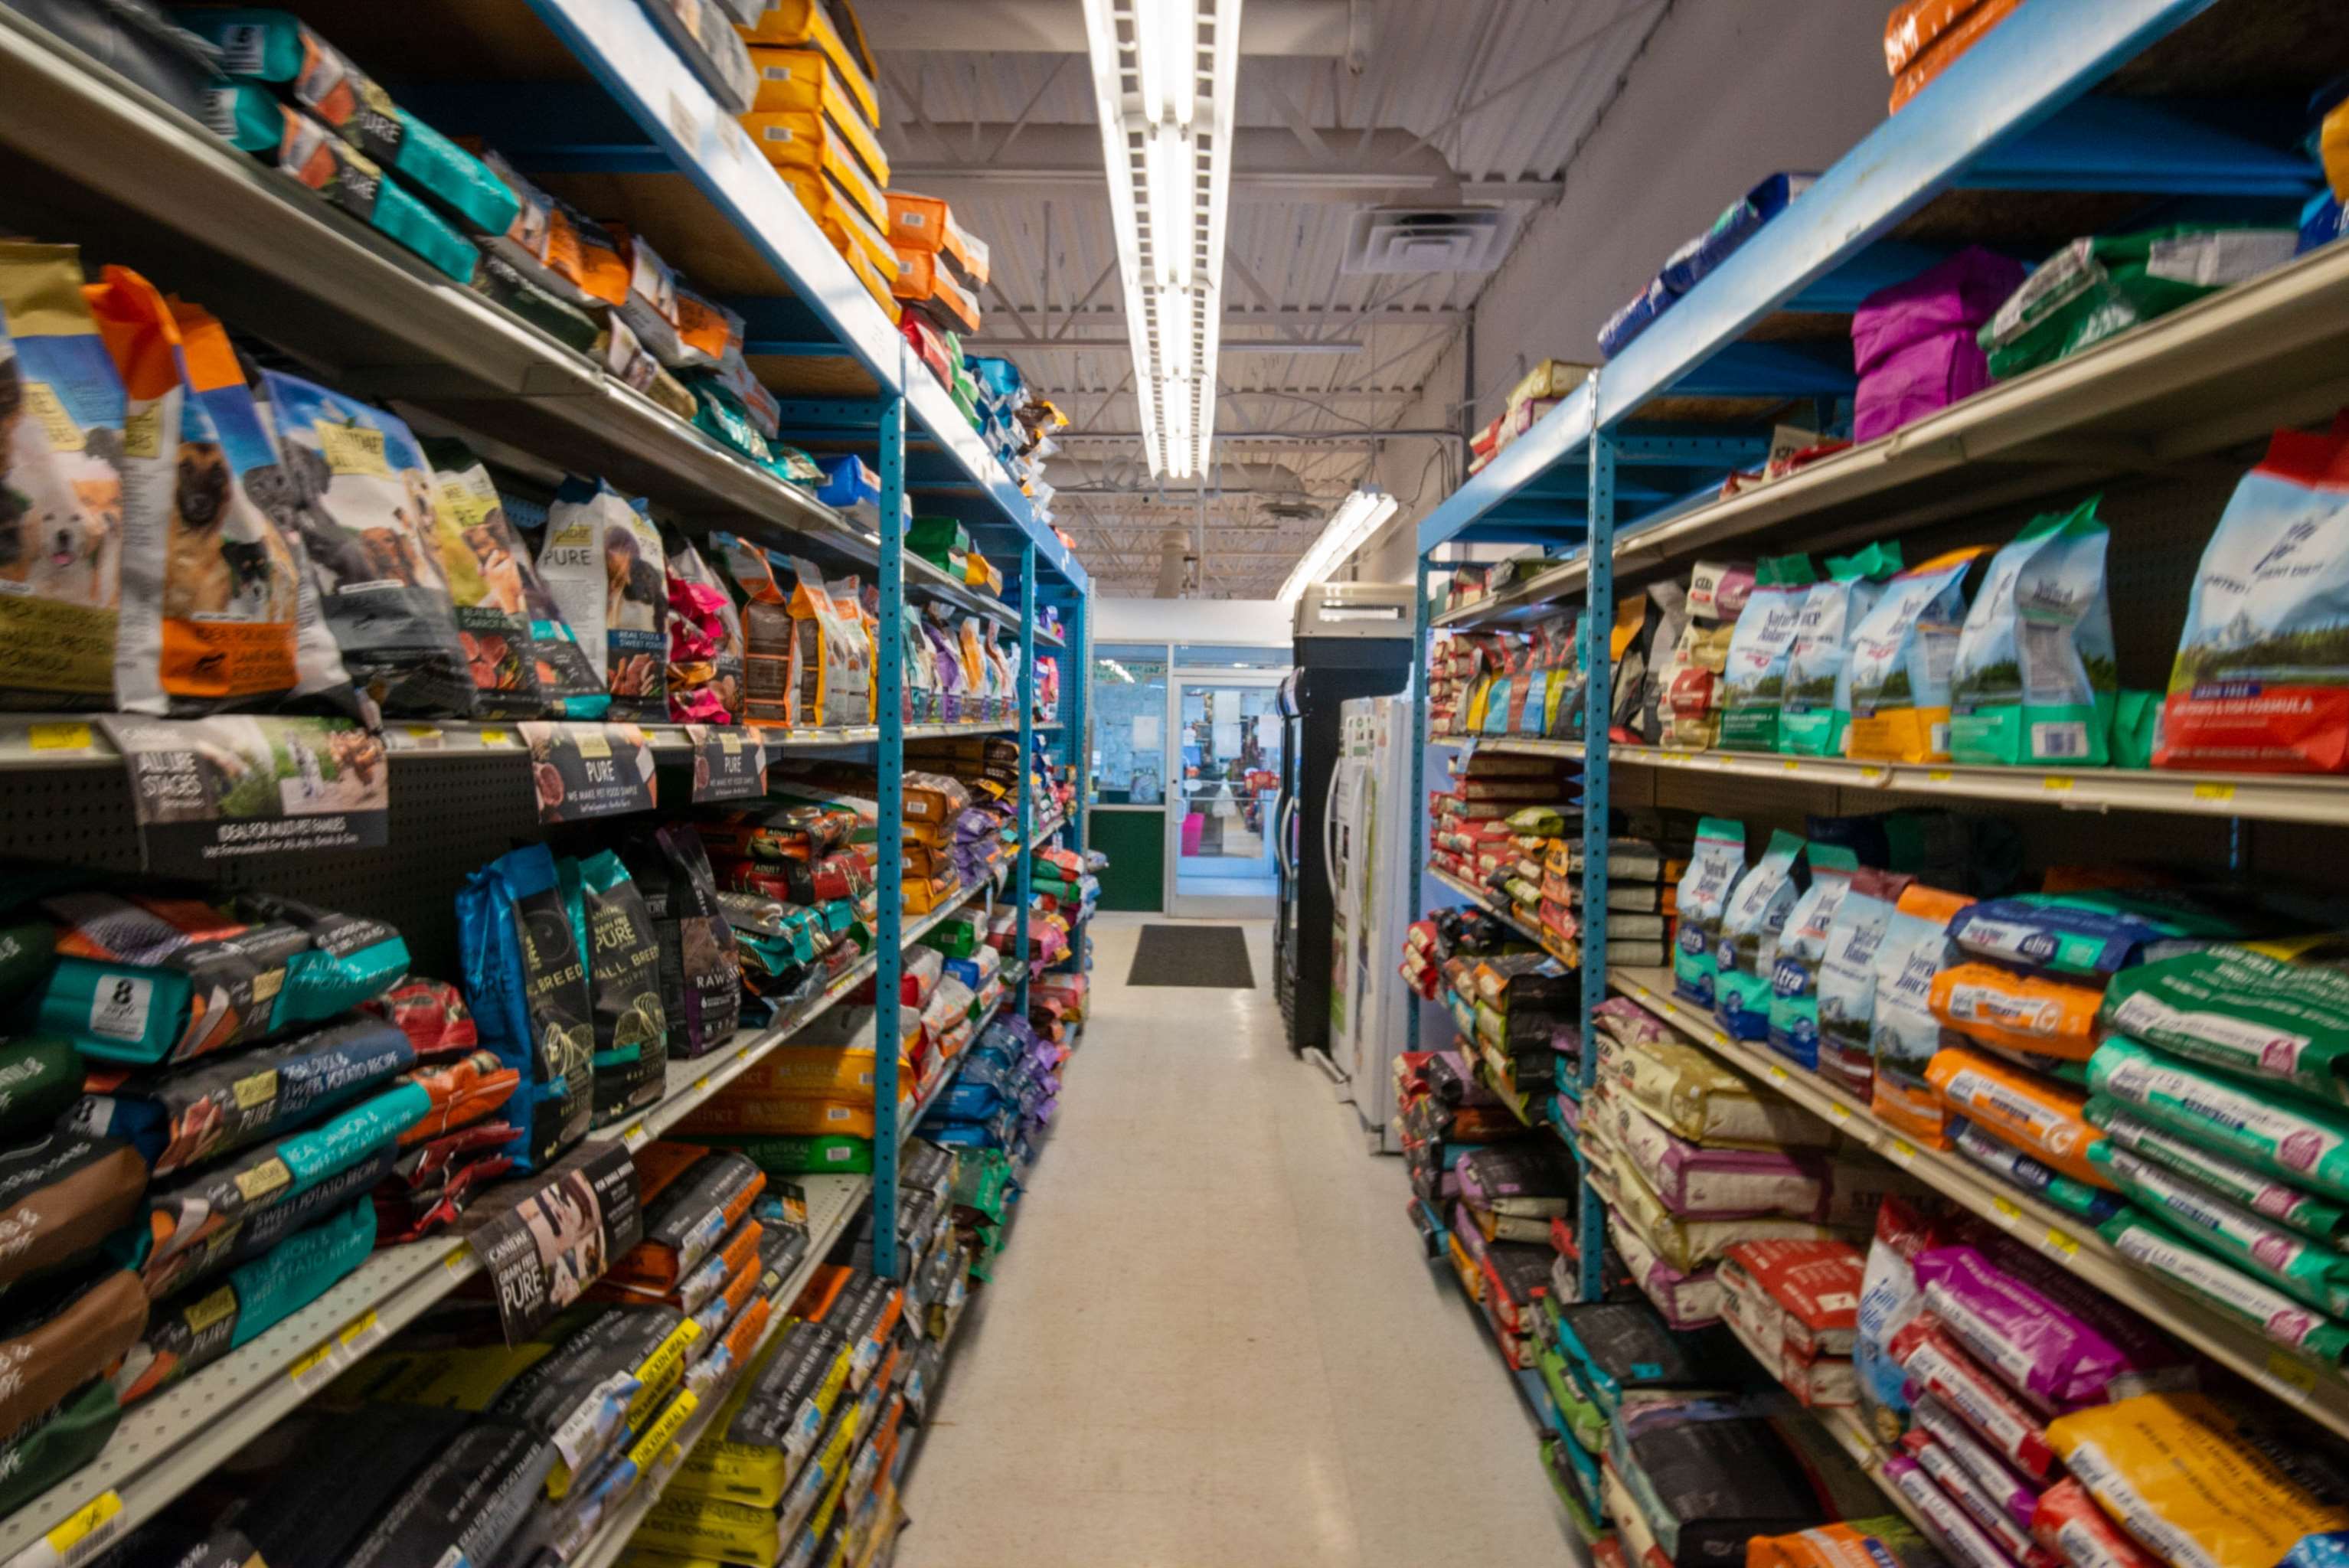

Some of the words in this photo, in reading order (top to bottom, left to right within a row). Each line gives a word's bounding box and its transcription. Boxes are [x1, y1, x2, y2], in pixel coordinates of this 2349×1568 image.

[543, 549, 592, 566] PURE
[584, 761, 616, 783] PURE
[724, 756, 742, 773] PURE
[141, 774, 202, 798] STAGES
[647, 900, 667, 913] URE
[595, 926, 635, 954] PURE
[630, 943, 660, 967] BREED
[537, 963, 583, 991] BREED
[112, 978, 135, 1004] 8
[299, 1177, 345, 1207] POTATO
[501, 1265, 544, 1318] PURE
